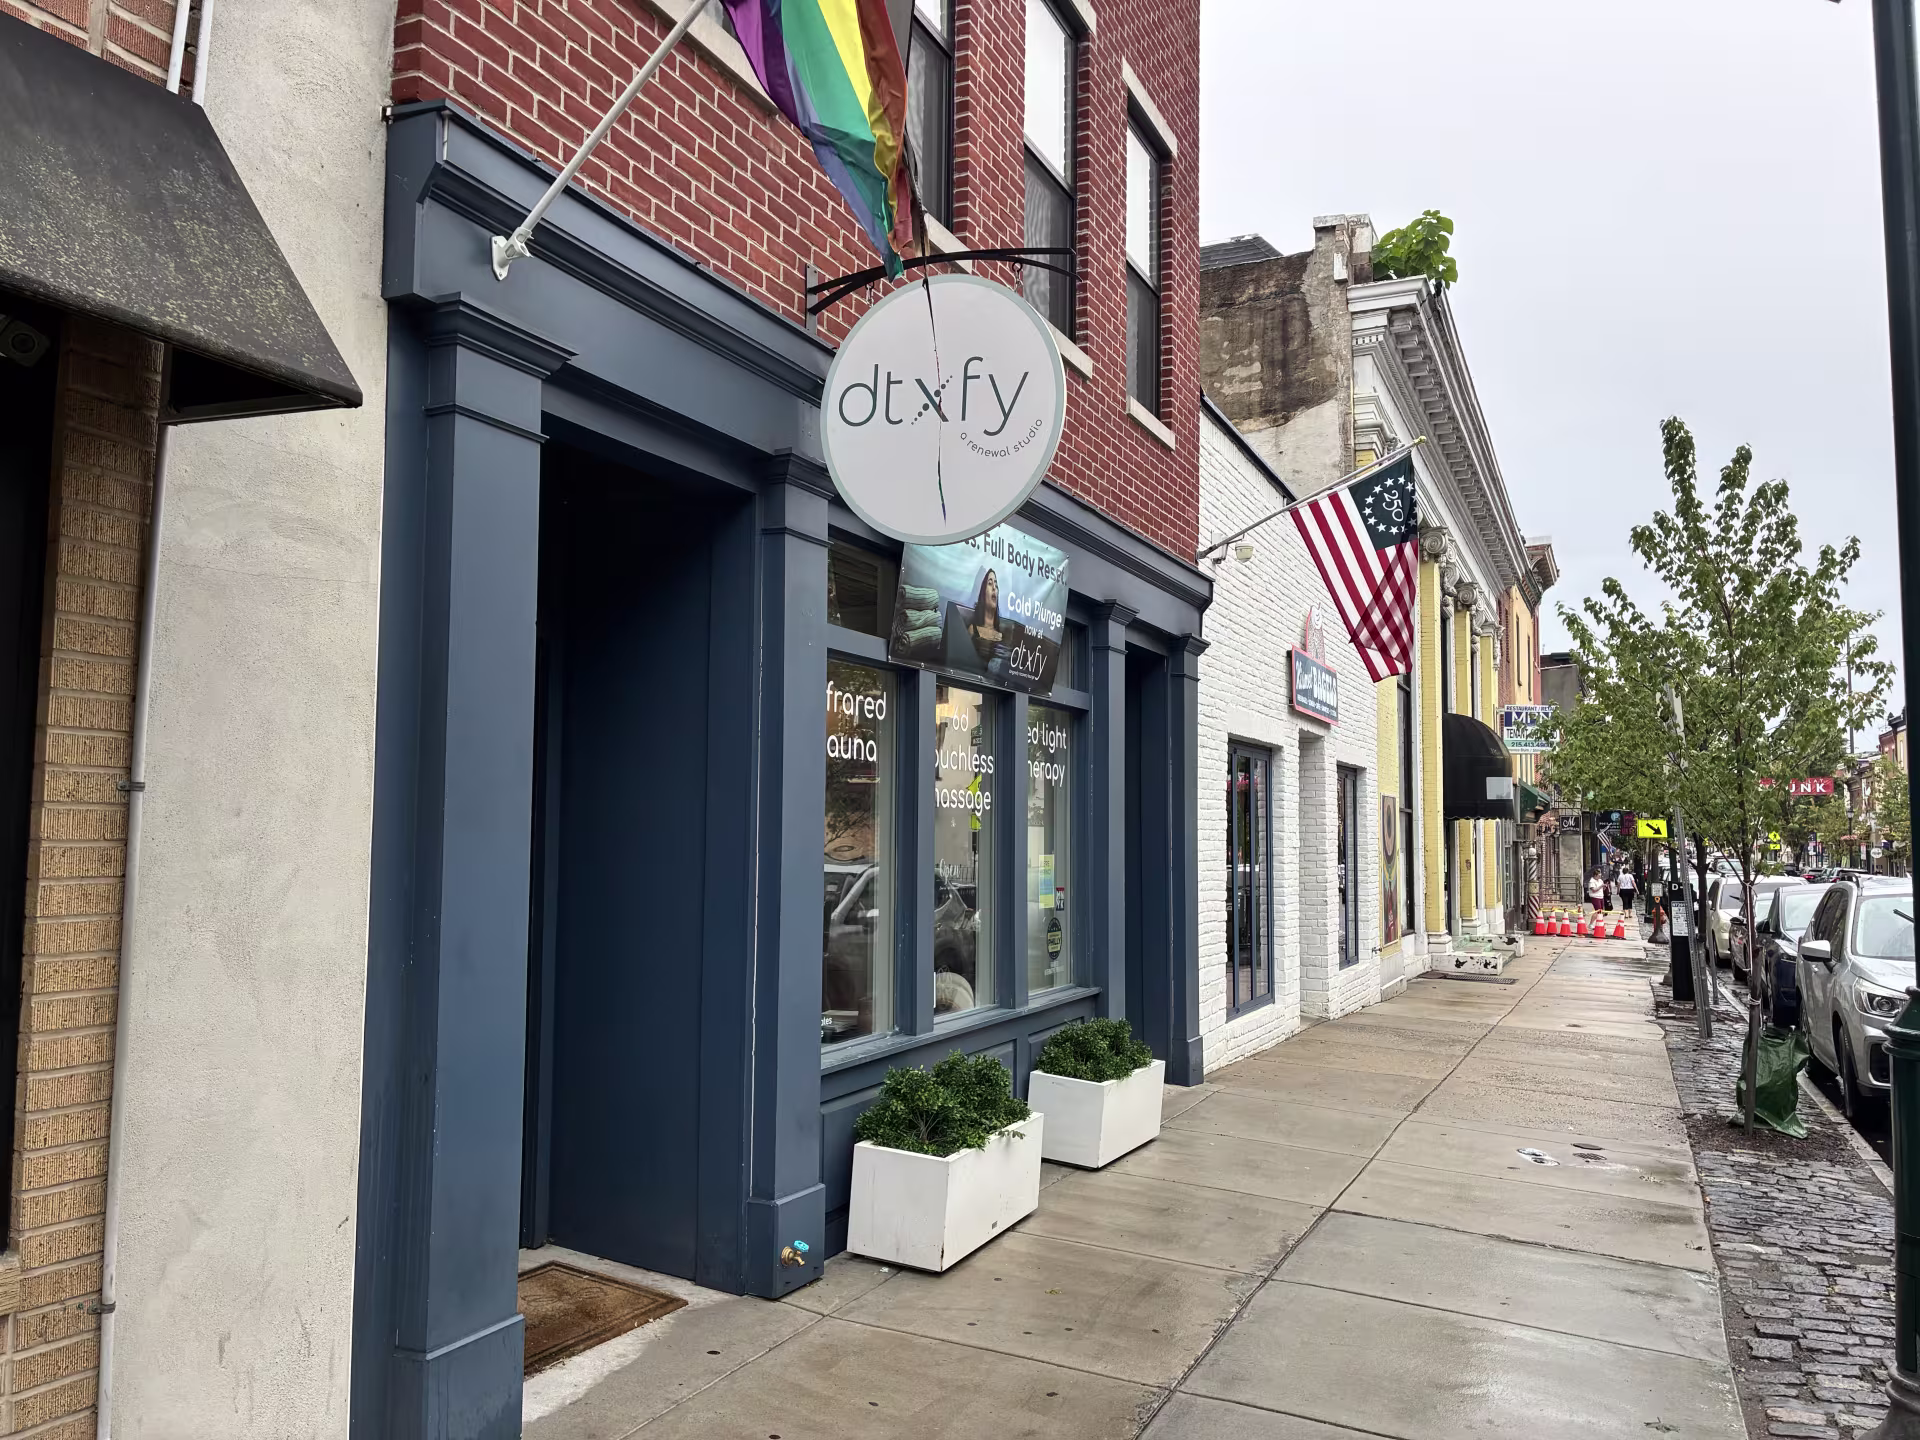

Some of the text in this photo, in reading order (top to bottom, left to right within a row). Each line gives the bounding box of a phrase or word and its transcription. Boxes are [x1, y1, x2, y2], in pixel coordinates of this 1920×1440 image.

[838, 356, 1030, 436] dtxfy
[960, 419, 1043, 457] a renewal studio
[1382, 489, 1404, 522] 250
[983, 533, 1005, 560] Full
[1007, 542, 1035, 578] Body
[1007, 592, 1032, 617] Cold
[1024, 625, 1044, 639] now at
[826, 680, 887, 720] frared
[952, 705, 969, 732] 6d
[827, 735, 877, 762] auna
[1042, 722, 1067, 754] light
